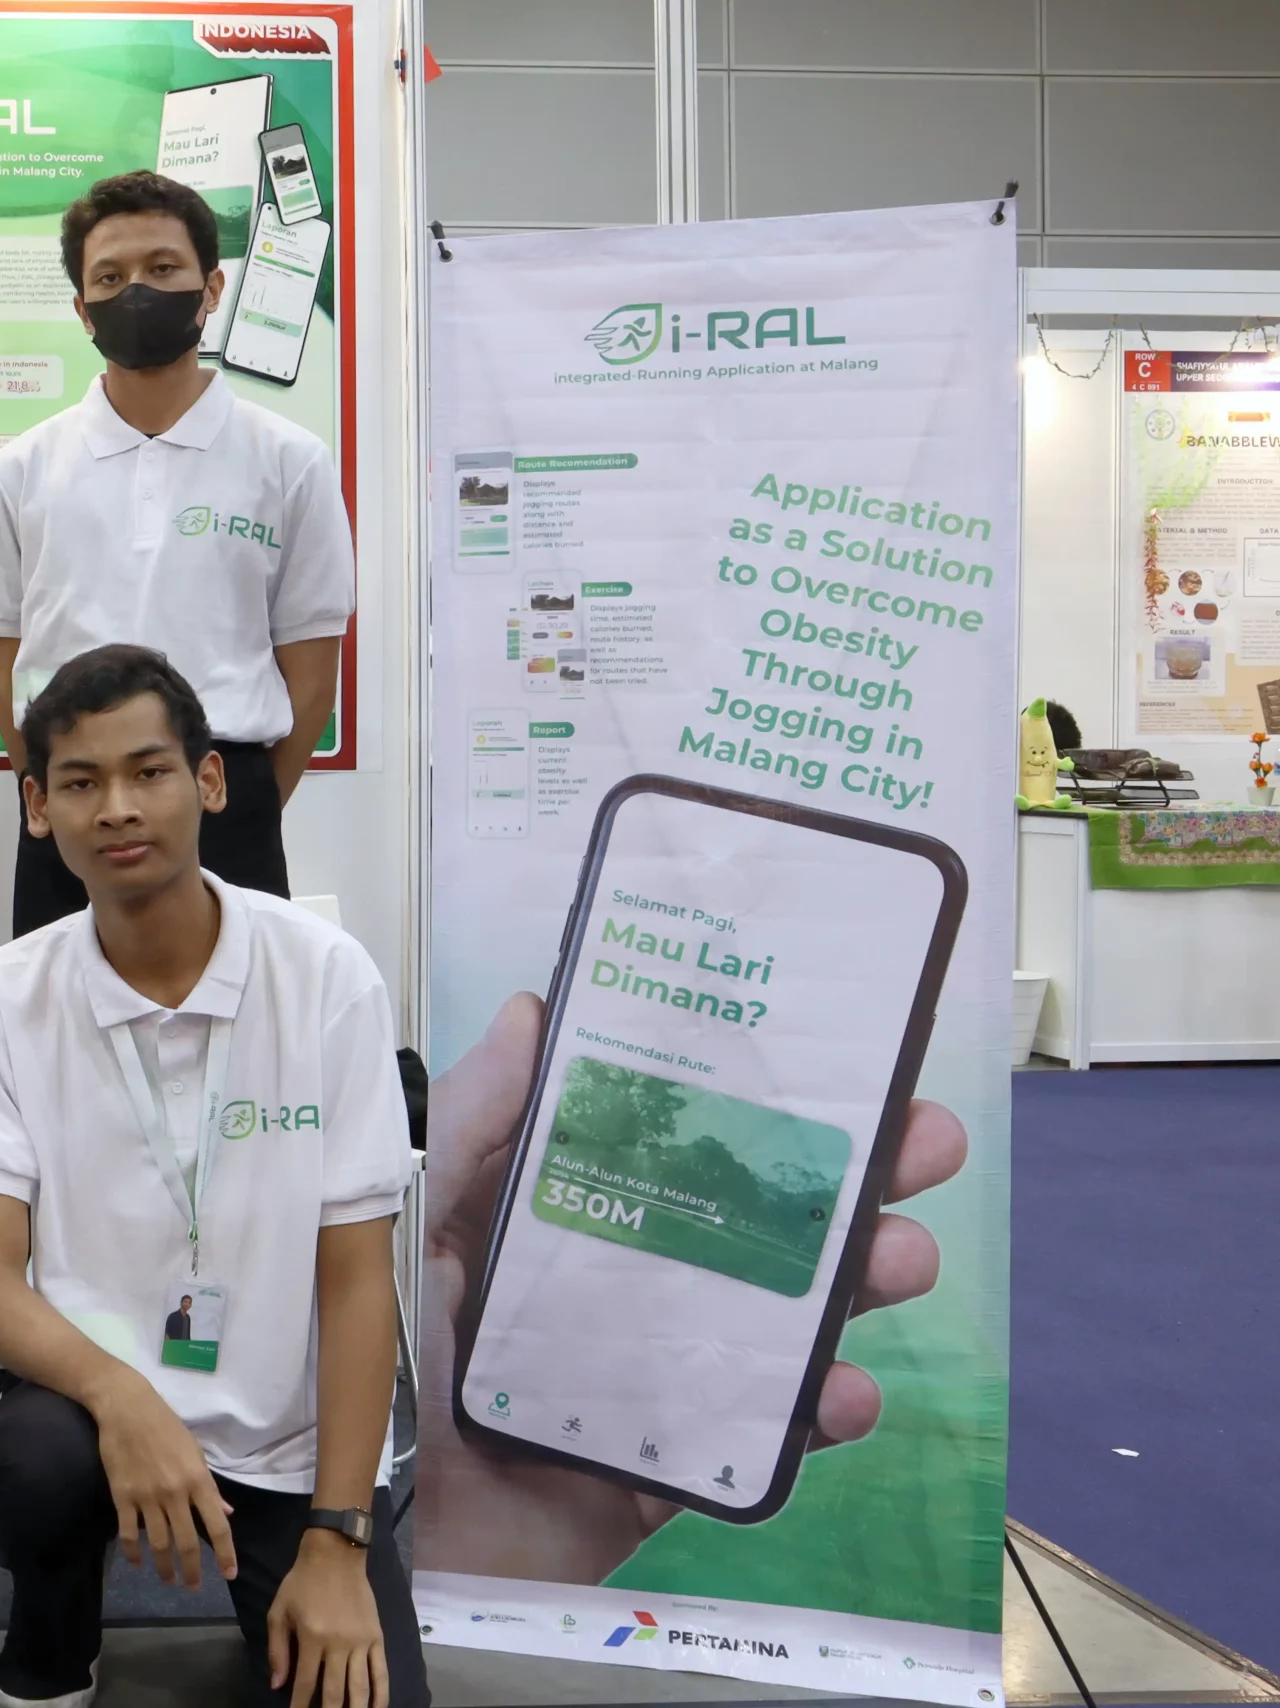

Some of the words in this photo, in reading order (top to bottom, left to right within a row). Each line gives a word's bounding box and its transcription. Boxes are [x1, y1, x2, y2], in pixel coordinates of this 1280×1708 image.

[199, 23, 312, 39] INDONESIA
[163, 139, 191, 152] Mau
[195, 133, 219, 148] Lari
[29, 152, 41, 162] to
[44, 152, 105, 163] Overcome
[162, 151, 219, 169] Dimana?
[0, 166, 9, 176] in
[13, 166, 56, 178] Malang
[59, 166, 85, 178] City.
[261, 220, 297, 238] Laporan
[671, 306, 846, 353] i-RAL
[1135, 353, 1156, 361] ROW
[706, 361, 796, 379] Application
[799, 361, 816, 372] at
[820, 356, 879, 372] Malang
[1138, 362, 1152, 378] C
[518, 460, 547, 469] Route
[523, 480, 556, 488] Displays
[523, 489, 582, 497] recommended
[523, 500, 553, 509] jogging
[555, 499, 581, 507] routes
[750, 473, 992, 541] Application
[523, 511, 545, 519] along
[547, 509, 565, 517] with
[213, 512, 282, 549] i-RAL
[523, 520, 556, 528] distance
[559, 519, 574, 528] and
[523, 530, 563, 539] estimated
[523, 541, 553, 549] calories
[554, 540, 584, 549] burned
[728, 517, 774, 545] as
[784, 528, 808, 552] a
[819, 529, 994, 588] Solution
[585, 586, 624, 594] Exercise
[718, 555, 758, 586] to
[771, 566, 984, 633] Overcome
[590, 604, 623, 613] Displays
[624, 604, 656, 613] jogging
[612, 614, 653, 622] estimated
[759, 608, 920, 671] Obesity
[590, 656, 664, 664] recommendations
[589, 667, 601, 675] for
[630, 666, 647, 674] that
[648, 666, 668, 674] have
[742, 648, 913, 712] Through
[532, 726, 567, 736] Report
[705, 687, 874, 754] Jogging
[885, 723, 924, 760] in
[538, 746, 571, 754] Displays
[538, 767, 567, 775] obesity
[678, 726, 829, 790] Malang
[840, 763, 934, 811] City!
[613, 888, 686, 920] Selamat
[692, 908, 738, 935] Pagi,
[601, 917, 686, 963] Mau
[696, 941, 775, 986] Lari
[590, 958, 768, 1029] Dimana?
[576, 1026, 675, 1065] Rekomendasi
[677, 1054, 717, 1076] Rute:
[551, 1154, 623, 1185] Alun-Alun
[626, 1175, 660, 1197] Kota
[662, 1185, 719, 1215] Malang
[541, 1178, 646, 1231] 350M
